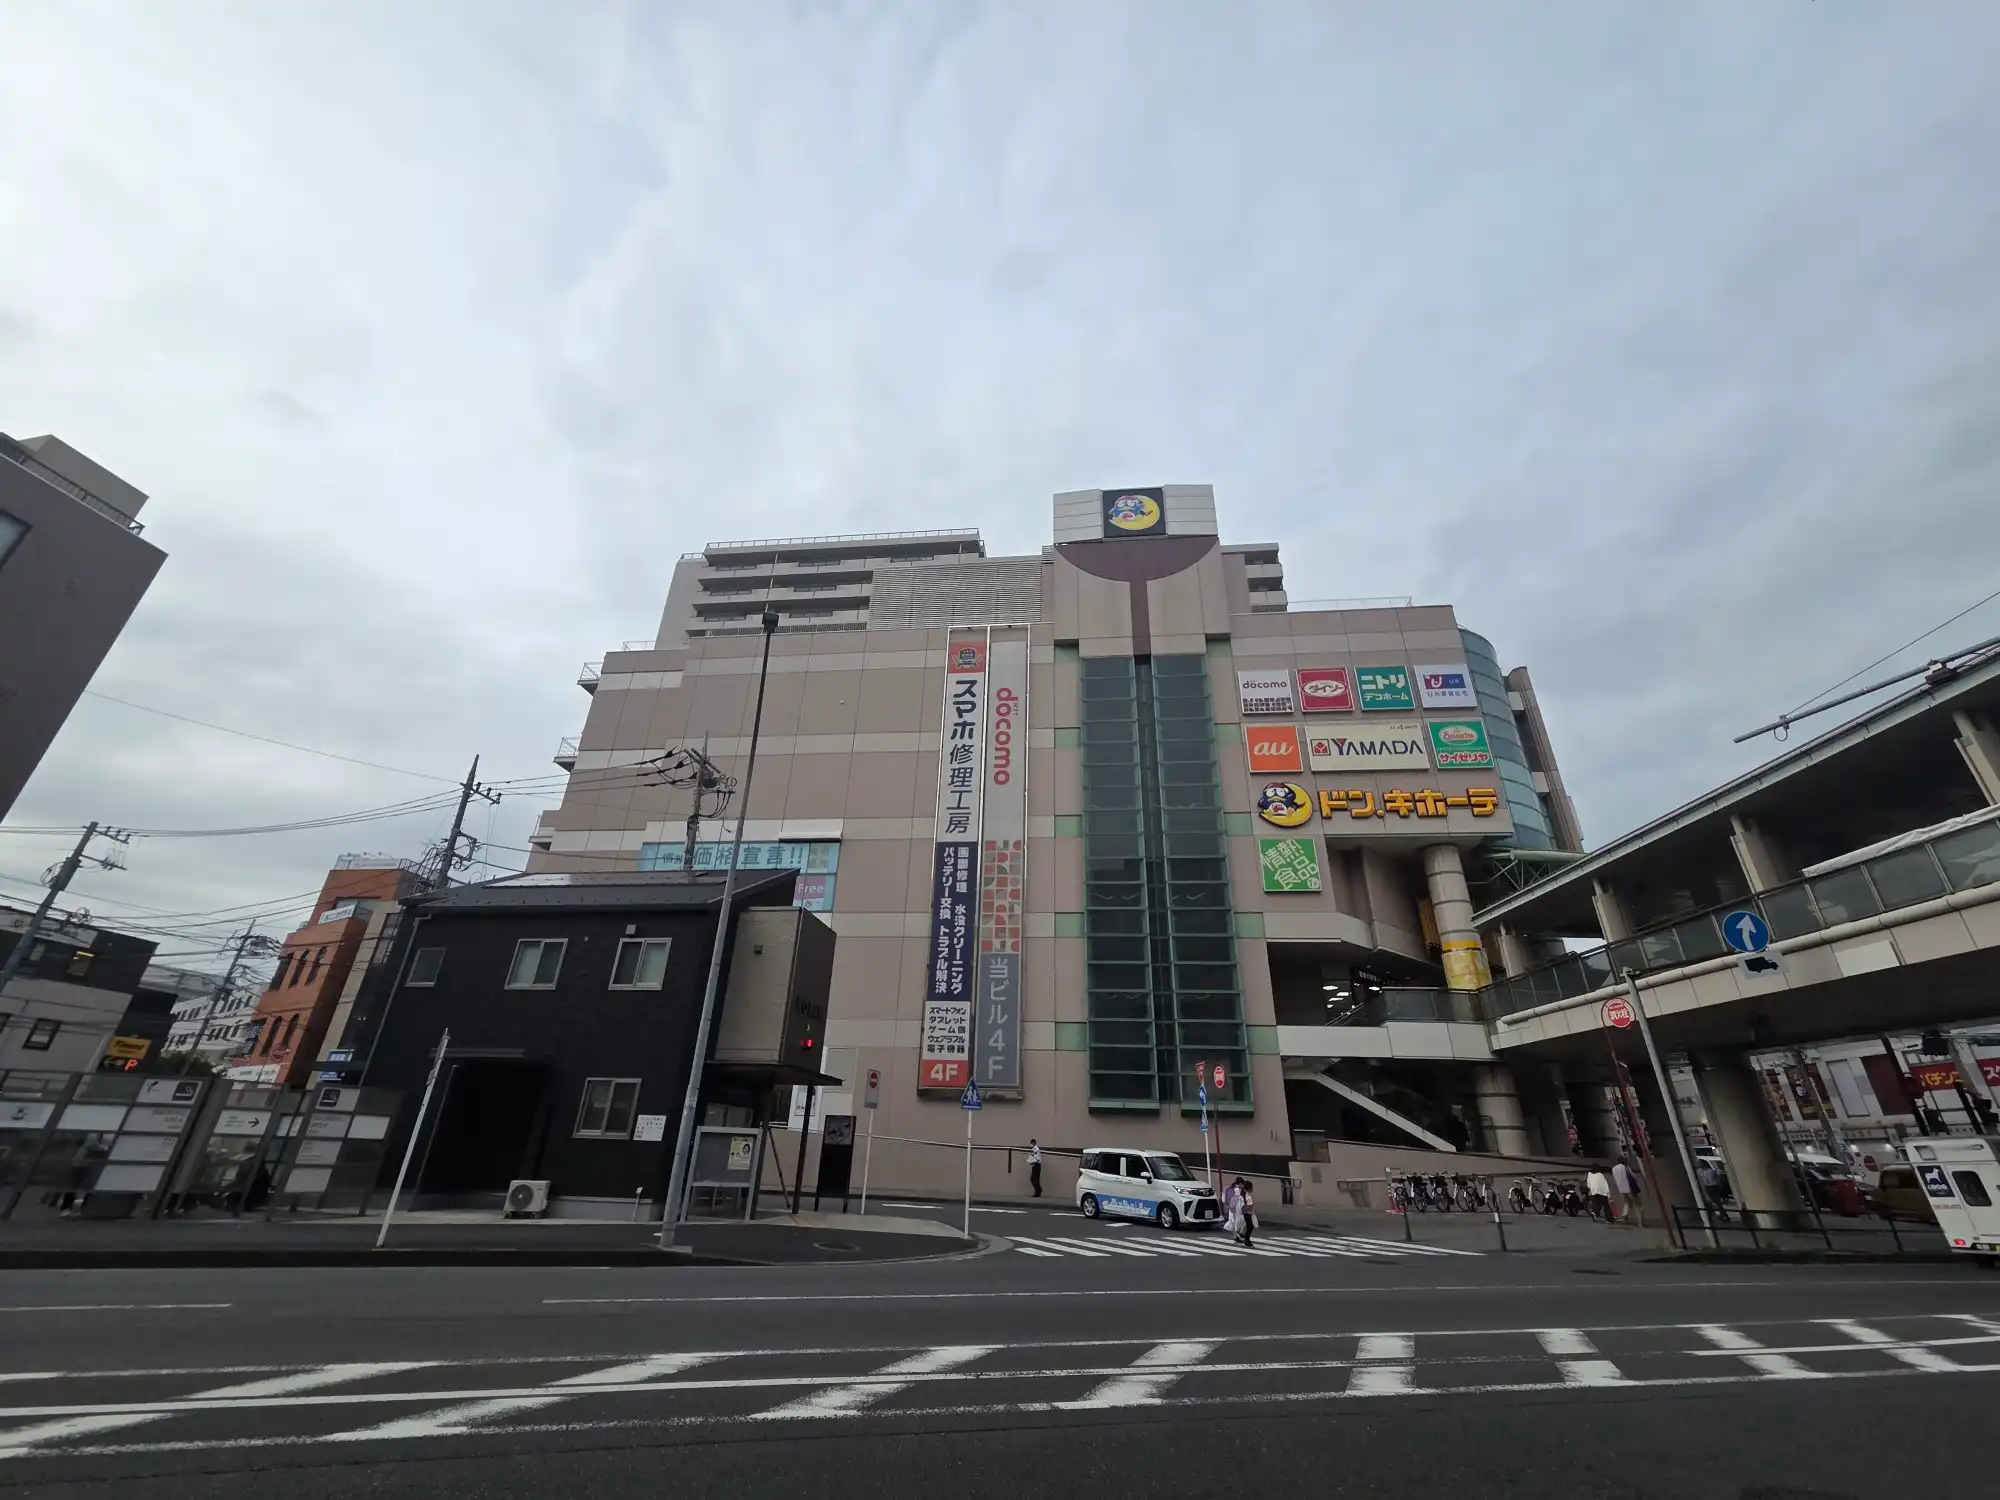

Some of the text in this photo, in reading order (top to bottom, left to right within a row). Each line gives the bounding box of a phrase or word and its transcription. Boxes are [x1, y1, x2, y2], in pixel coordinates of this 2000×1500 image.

[1242, 680, 1287, 689] docomo
[1308, 684, 1344, 694] ダイソー
[1361, 674, 1406, 690] ニトリ
[1363, 692, 1409, 702] デコホーム
[993, 687, 1019, 786] docomo
[1253, 741, 1295, 756] au
[1330, 738, 1424, 756] YAMADA
[945, 679, 978, 834] スマホ修理工房
[1438, 751, 1489, 764] サイゼリヤ
[798, 883, 825, 894] Free
[935, 846, 955, 994] バッテリー交換 トラブル解決
[951, 846, 970, 995] 画面修理 水没クリーニング
[929, 1006, 967, 1015] スマートフォン
[928, 1016, 967, 1025] タブレット
[124, 1059, 138, 1071] P
[930, 1063, 959, 1082] 4F
